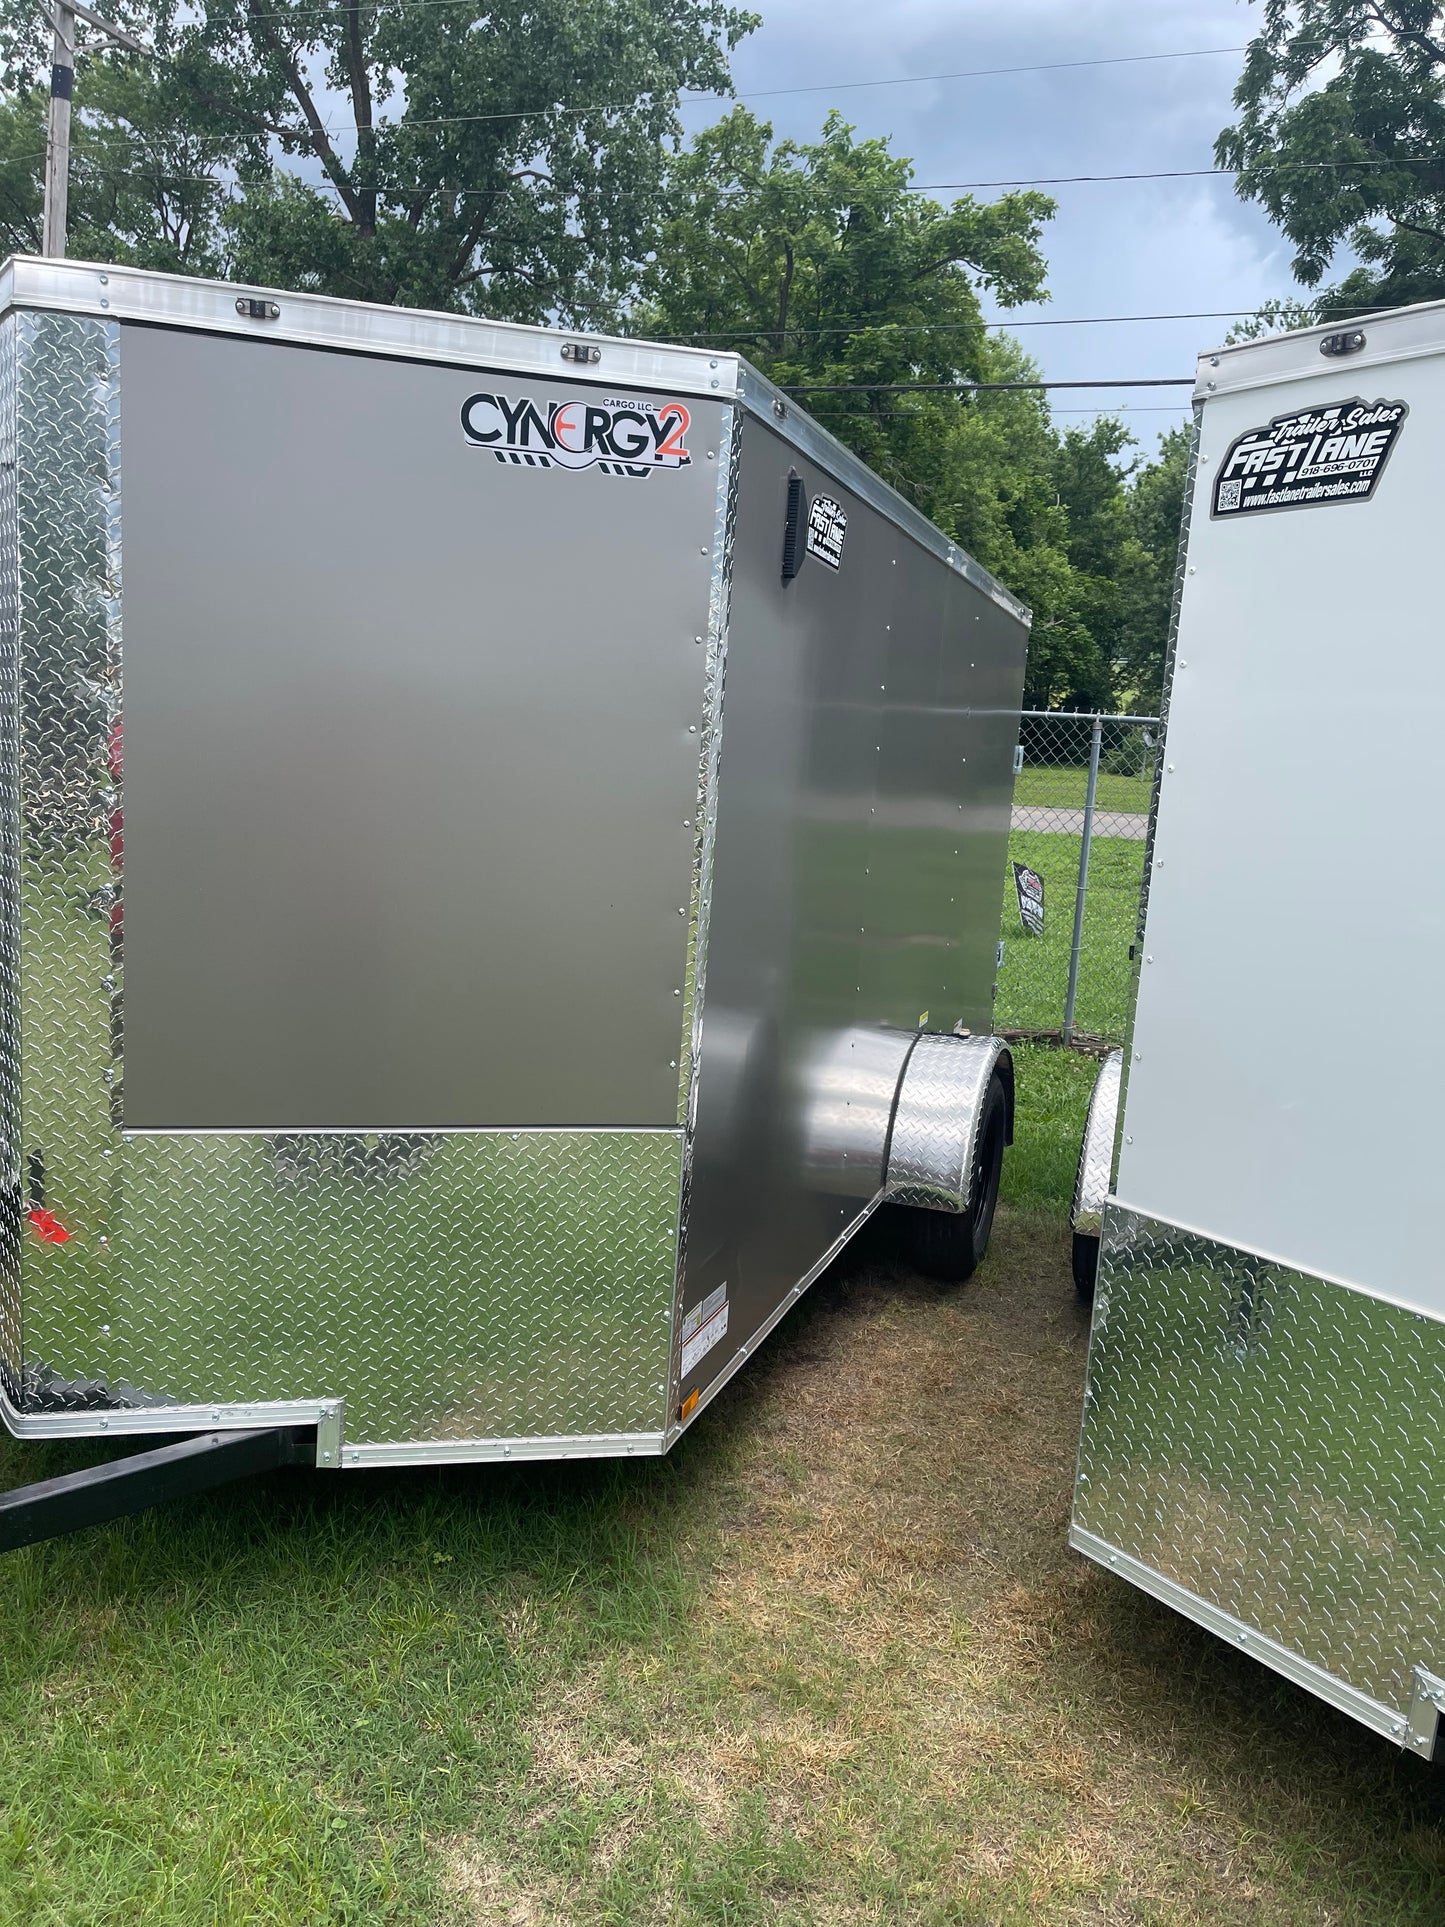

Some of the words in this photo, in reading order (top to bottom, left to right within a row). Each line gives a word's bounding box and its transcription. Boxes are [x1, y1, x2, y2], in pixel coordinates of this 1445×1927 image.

[603, 398, 635, 410] CARGO
[637, 402, 652, 412] LLC
[1275, 417, 1340, 442] Trailer
[1343, 406, 1402, 431] Sales
[1223, 440, 1309, 479] FAST
[1301, 459, 1376, 476] 918-696-0701
[1243, 479, 1371, 507] www.fastlanetrailersales.com
